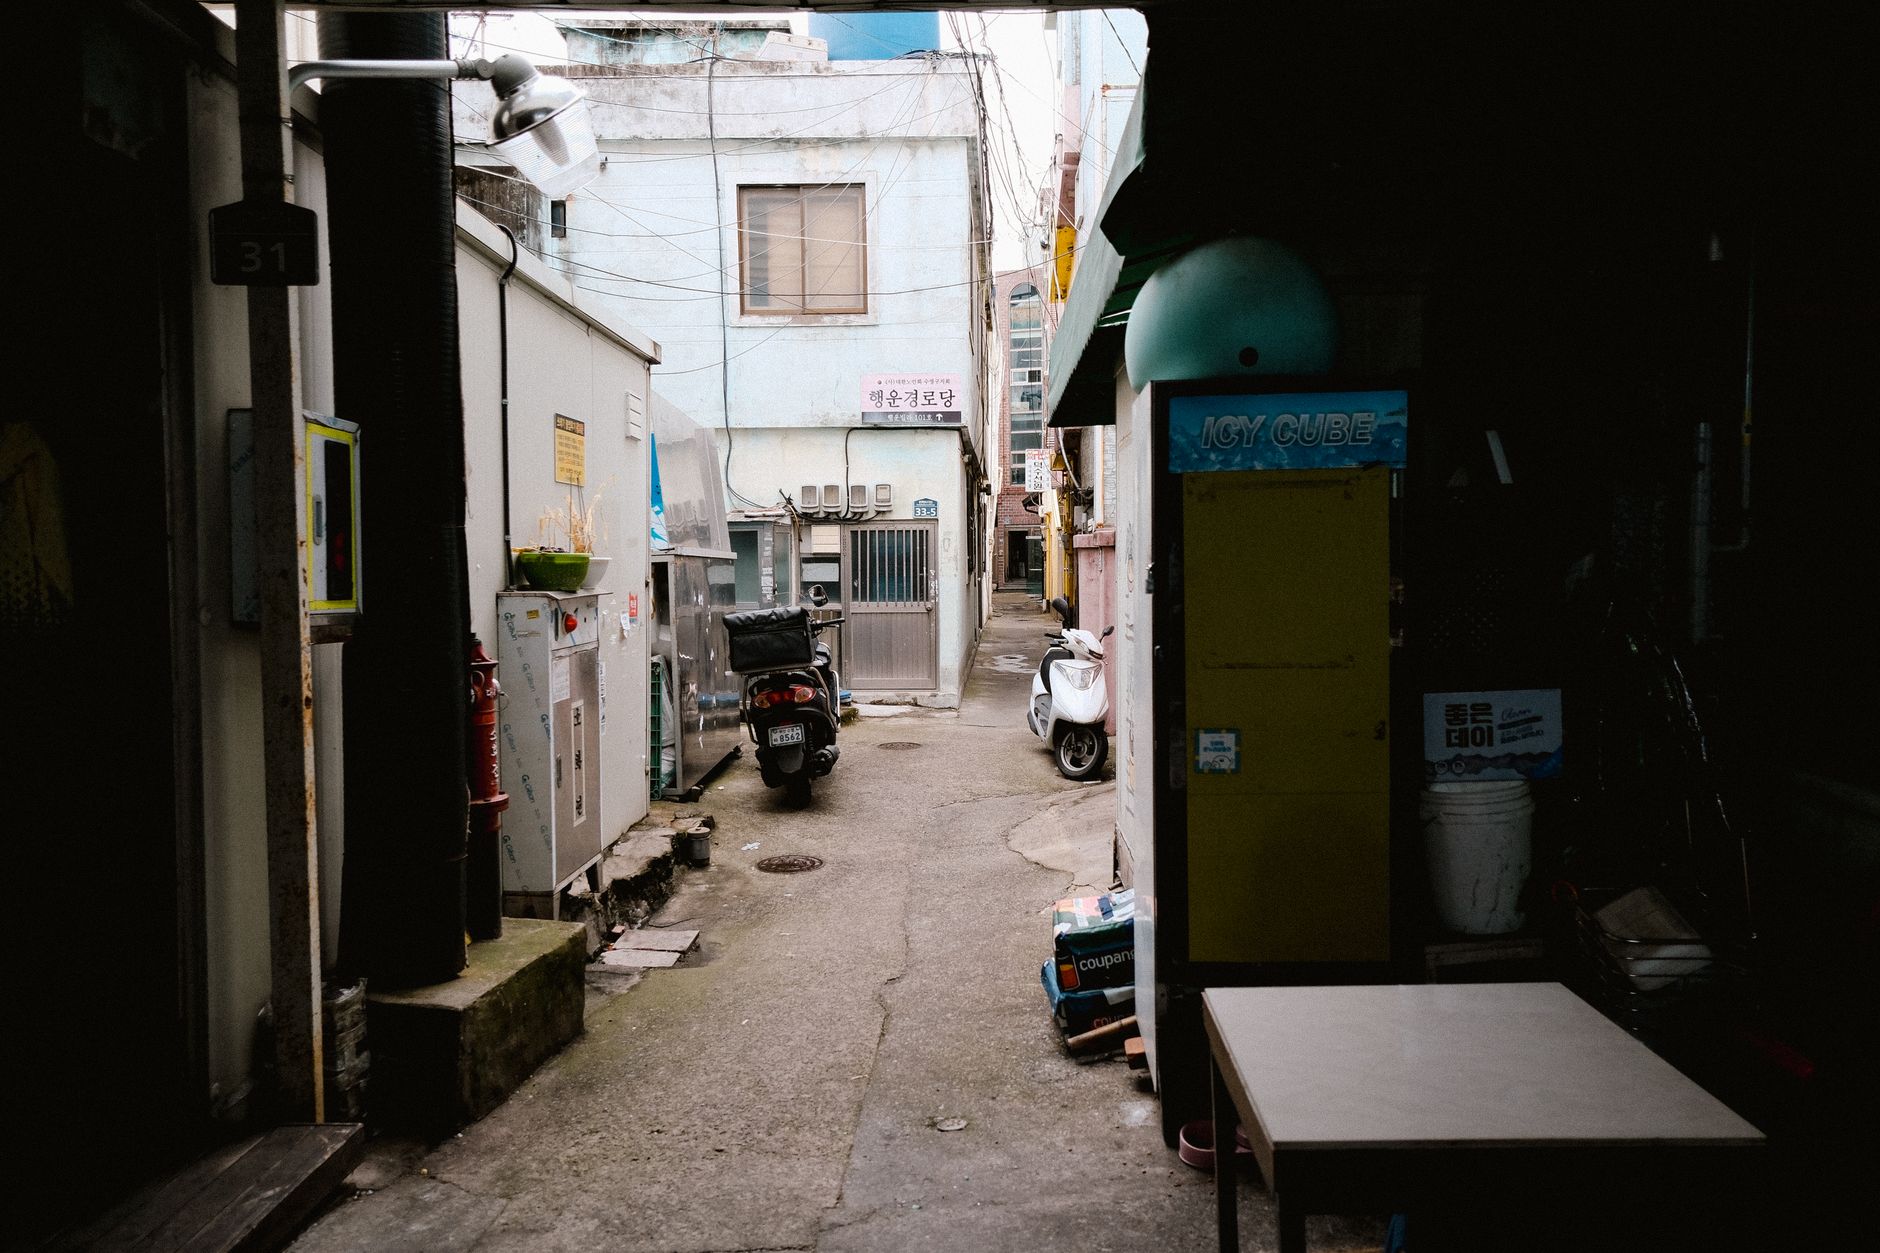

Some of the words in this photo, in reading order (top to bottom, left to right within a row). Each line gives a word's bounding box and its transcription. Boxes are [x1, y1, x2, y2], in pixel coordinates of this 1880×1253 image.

[239, 240, 286, 273] 31
[868, 388, 956, 409] 행운경로당
[1200, 414, 1267, 449] ICY
[1271, 411, 1376, 447] CUBE
[915, 507, 936, 516] 33-5
[1445, 702, 1493, 726] 좋은
[779, 732, 801, 743] 8562
[1445, 725, 1494, 748] 데이
